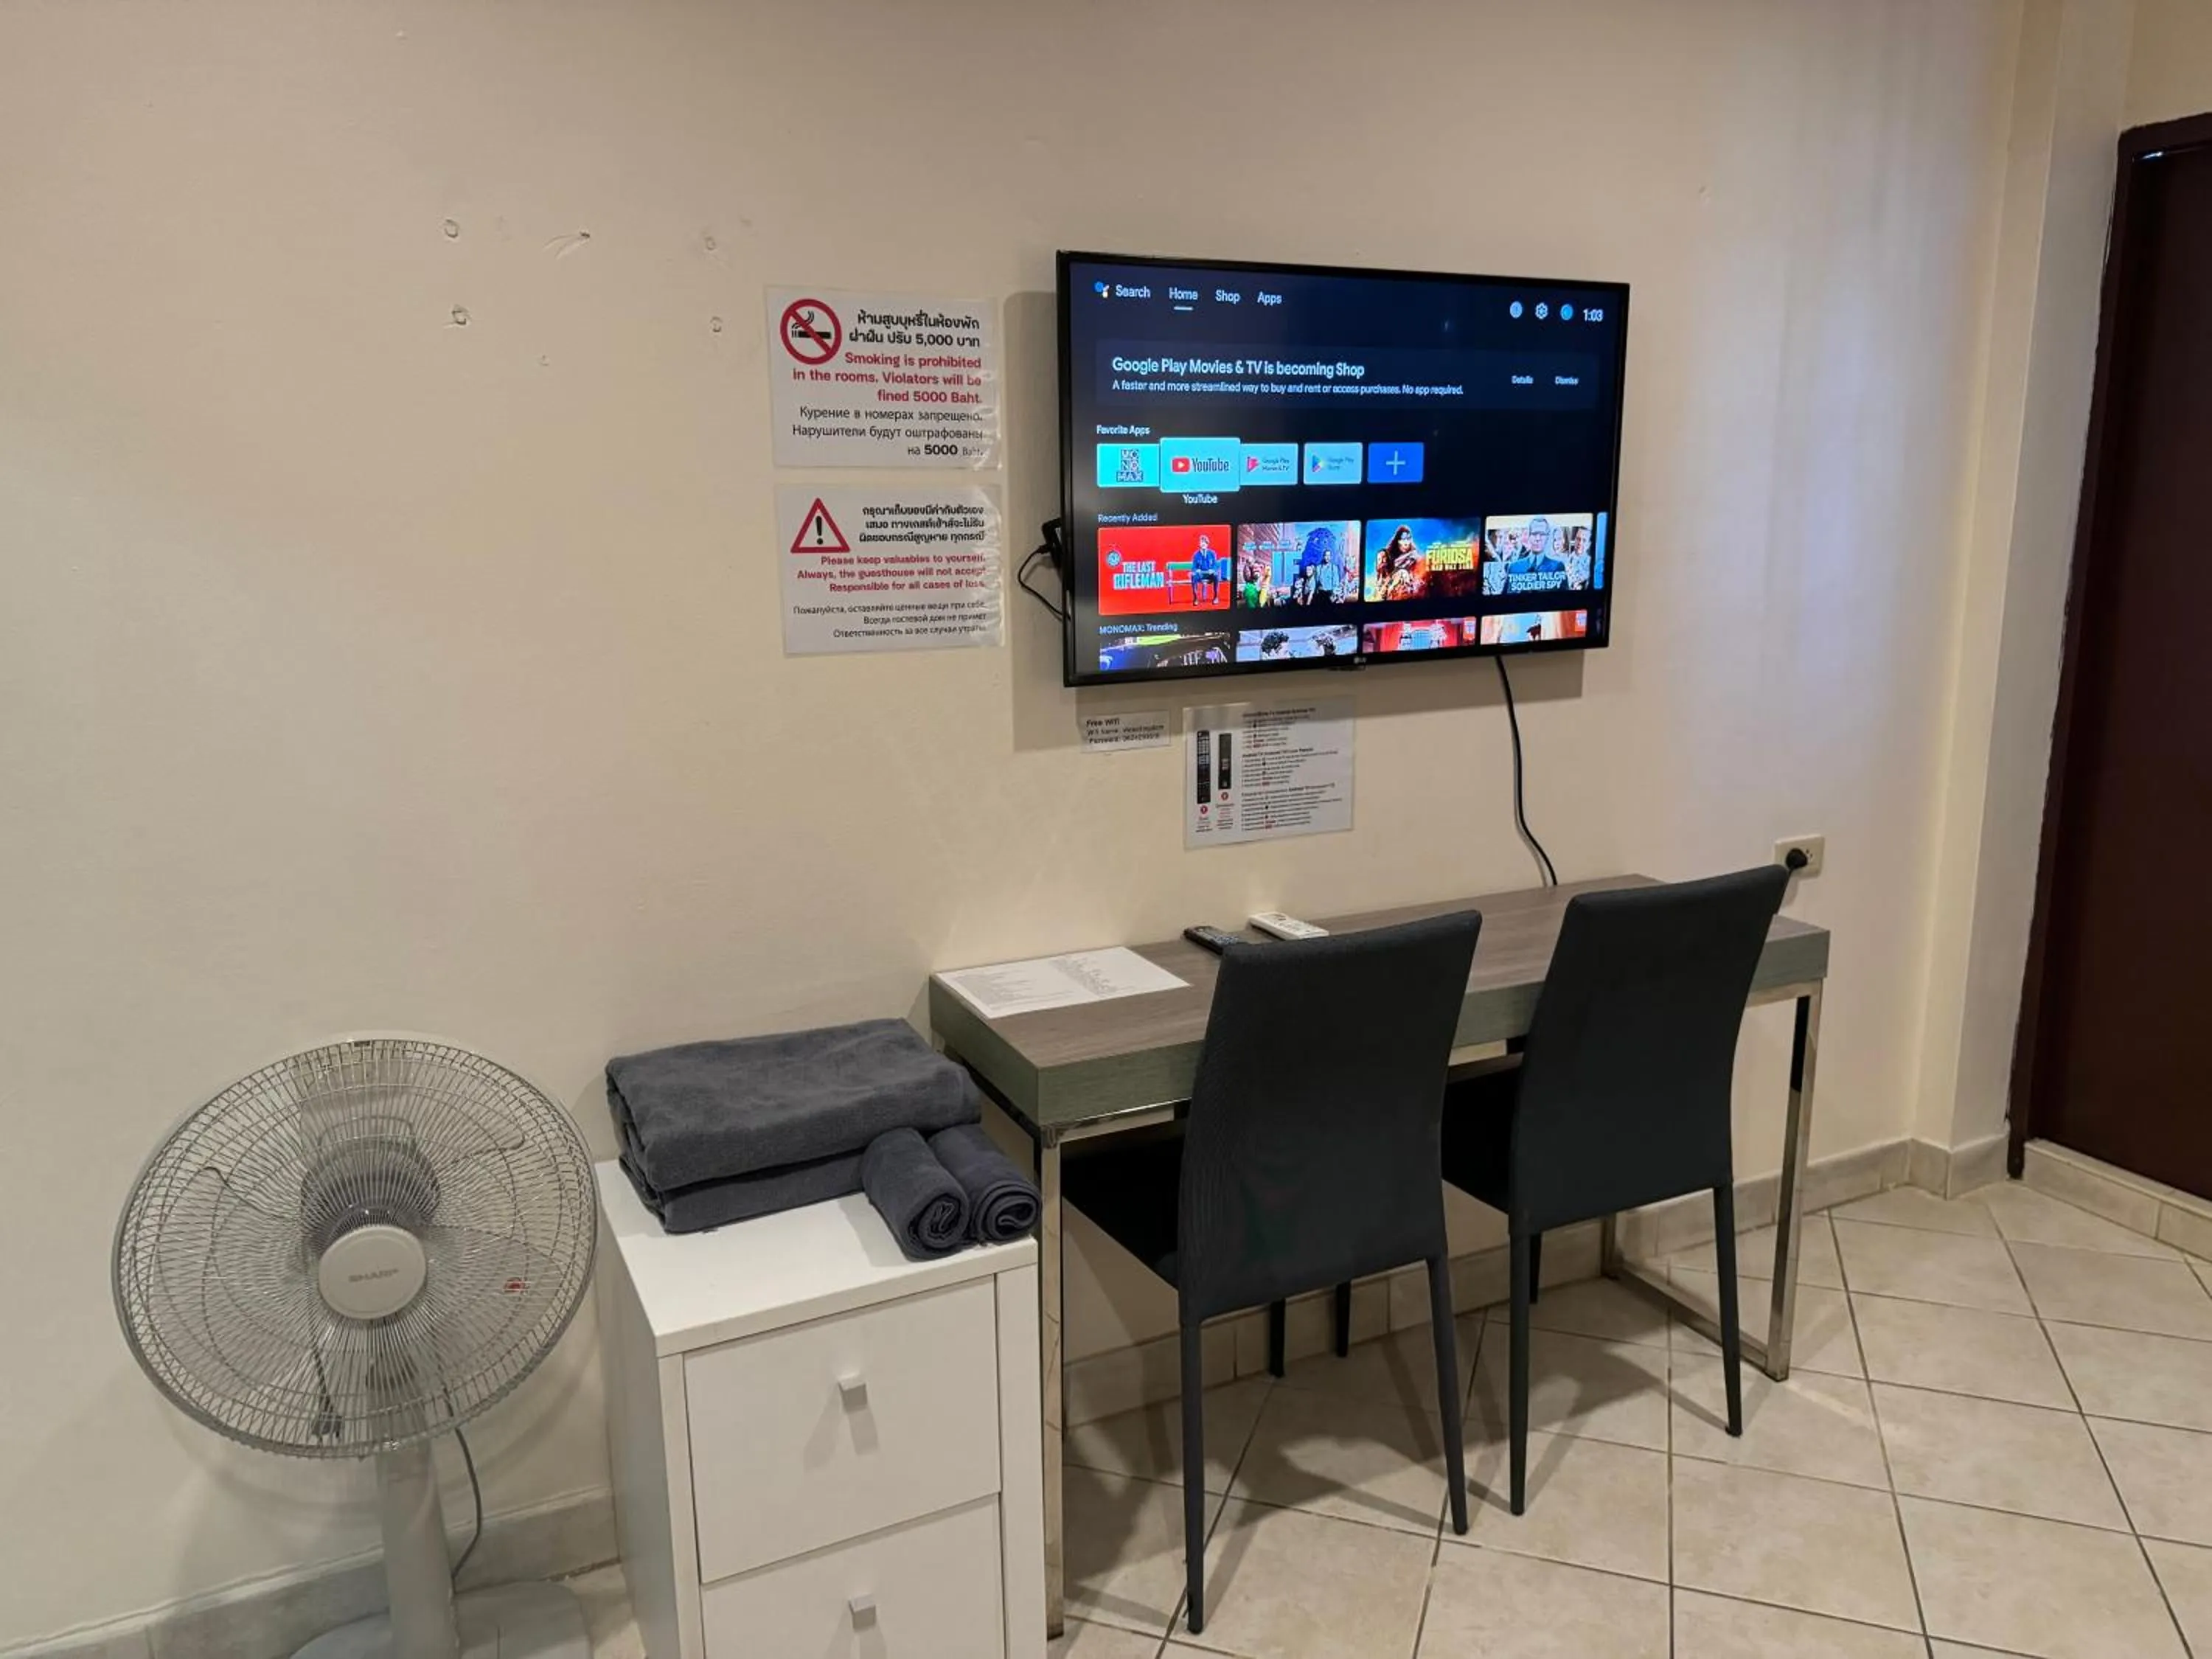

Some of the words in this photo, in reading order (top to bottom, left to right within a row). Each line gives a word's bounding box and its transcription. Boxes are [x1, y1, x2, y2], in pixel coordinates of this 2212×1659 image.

[1116, 284, 1151, 299] Search
[1169, 287, 1198, 301] Home
[1215, 289, 1240, 304] Shop
[1256, 291, 1282, 306] Apps
[858, 309, 980, 330] ห้ามสูบบุหรี่ในห้องพัก
[1583, 308, 1604, 321] 1:03
[887, 331, 912, 344] ปรับ
[915, 333, 953, 347] 5,000
[957, 336, 981, 347] บาท
[845, 351, 900, 368] Smoking
[904, 354, 915, 366] is
[919, 355, 981, 369] prohibited
[1112, 357, 1158, 375] Google
[1161, 358, 1187, 376] Play
[1189, 359, 1233, 375] Movies
[1235, 360, 1244, 374] &
[1246, 361, 1263, 375] TV
[1264, 361, 1274, 375] is
[1276, 361, 1334, 379] becoming
[1336, 362, 1365, 380] Shop
[810, 369, 830, 381] the
[835, 372, 878, 383] rooms.
[883, 372, 939, 384] Violators
[943, 374, 963, 386] will
[967, 375, 981, 386] be
[1112, 379, 1120, 390] A
[1121, 380, 1147, 391] faster
[1149, 380, 1165, 392] and
[1167, 382, 1189, 392] more
[1191, 381, 1240, 392] streamlined
[1242, 383, 1259, 394] way
[1260, 383, 1269, 393] to
[1270, 383, 1286, 394] buy
[1287, 383, 1303, 393] and
[1304, 383, 1321, 393] rent
[1322, 385, 1332, 394] or
[1332, 385, 1359, 394] access
[1360, 384, 1401, 395] purchases.
[1402, 385, 1413, 394] No
[1415, 386, 1429, 396] app
[1430, 385, 1464, 396] required.
[877, 389, 909, 402] fined
[914, 391, 947, 403] 5000
[951, 392, 982, 404] Baht.
[800, 406, 850, 421] Курение
[854, 409, 860, 419] в
[865, 409, 914, 422] номерах
[793, 425, 866, 439] Нарушители
[869, 425, 901, 440] будут
[1096, 425, 1128, 434] Favorite
[1130, 425, 1151, 437] Apps
[908, 446, 921, 456] на
[924, 444, 958, 456] 5000
[1192, 457, 1229, 472] YouTube
[1183, 493, 1217, 504] YouTube
[1098, 513, 1131, 525] Recently
[1132, 512, 1158, 521] Added
[821, 556, 855, 566] Please
[858, 556, 881, 566] keep
[885, 554, 931, 564] valuables
[933, 554, 943, 563] to
[1425, 548, 1473, 565] FURIOSA
[797, 570, 836, 580] Always,
[839, 570, 856, 579] the
[858, 568, 915, 580] guesthouse
[917, 567, 933, 577] will
[936, 567, 953, 577] not
[1123, 560, 1136, 573] THE
[1138, 560, 1156, 573] LAST
[1113, 572, 1164, 590] RIFLEMAN
[1508, 572, 1537, 582] TINKER
[1538, 571, 1566, 581] TAILOR
[830, 582, 888, 593] Responsible
[891, 581, 905, 591] for
[908, 580, 920, 590] all
[922, 581, 950, 589] cases
[953, 580, 963, 588] of
[1512, 580, 1545, 591] SOLDIER
[1546, 580, 1562, 589] SPY
[1146, 623, 1178, 633] Trending
[1086, 719, 1103, 728] Free
